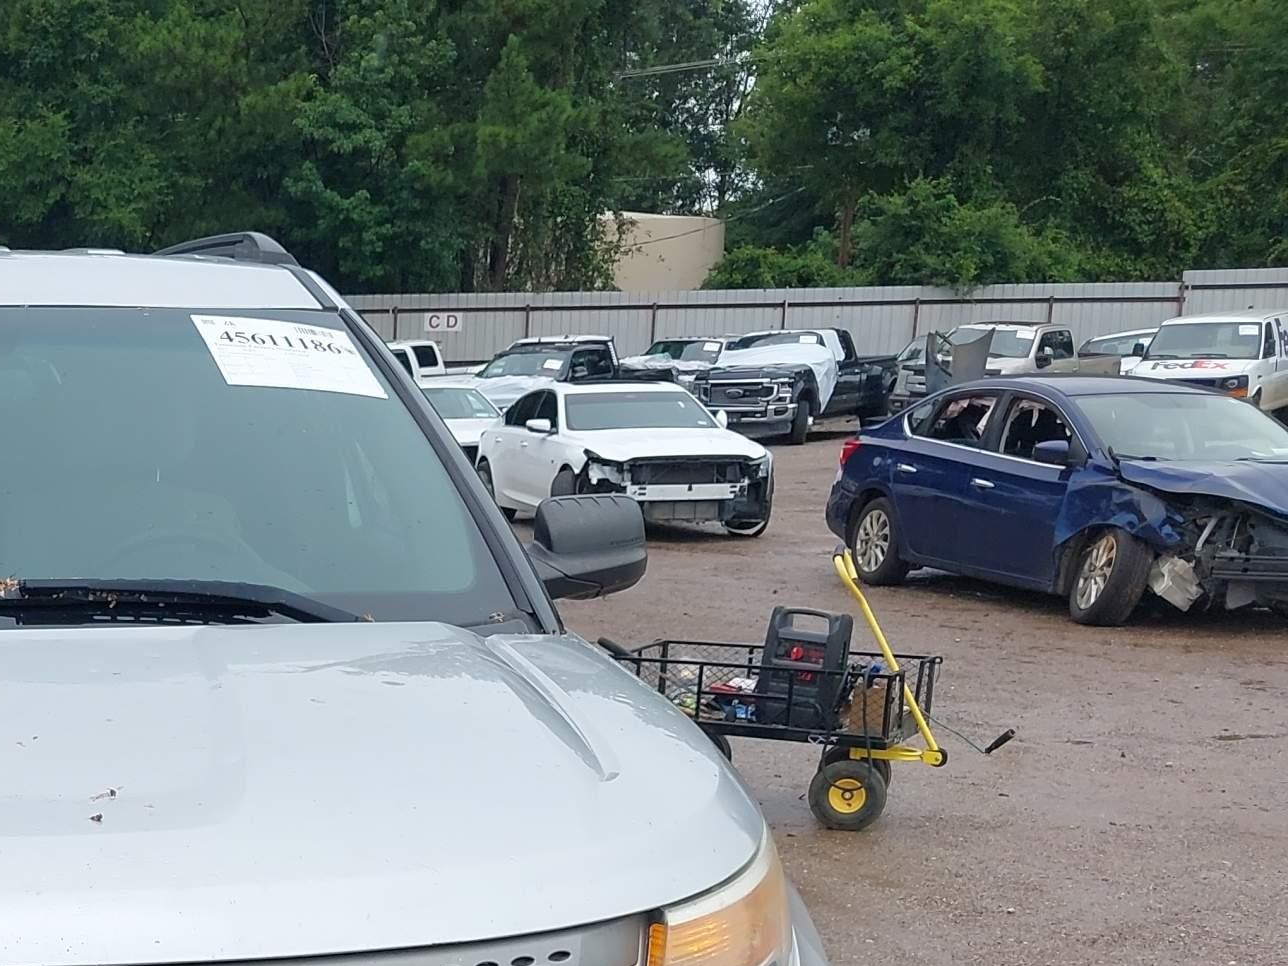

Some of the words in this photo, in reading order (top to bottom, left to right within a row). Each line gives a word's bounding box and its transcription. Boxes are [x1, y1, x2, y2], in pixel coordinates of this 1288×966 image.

[428, 315, 440, 328] C
[447, 315, 458, 328] D
[219, 330, 342, 355] 45611186
[1151, 360, 1230, 370] FedEx
